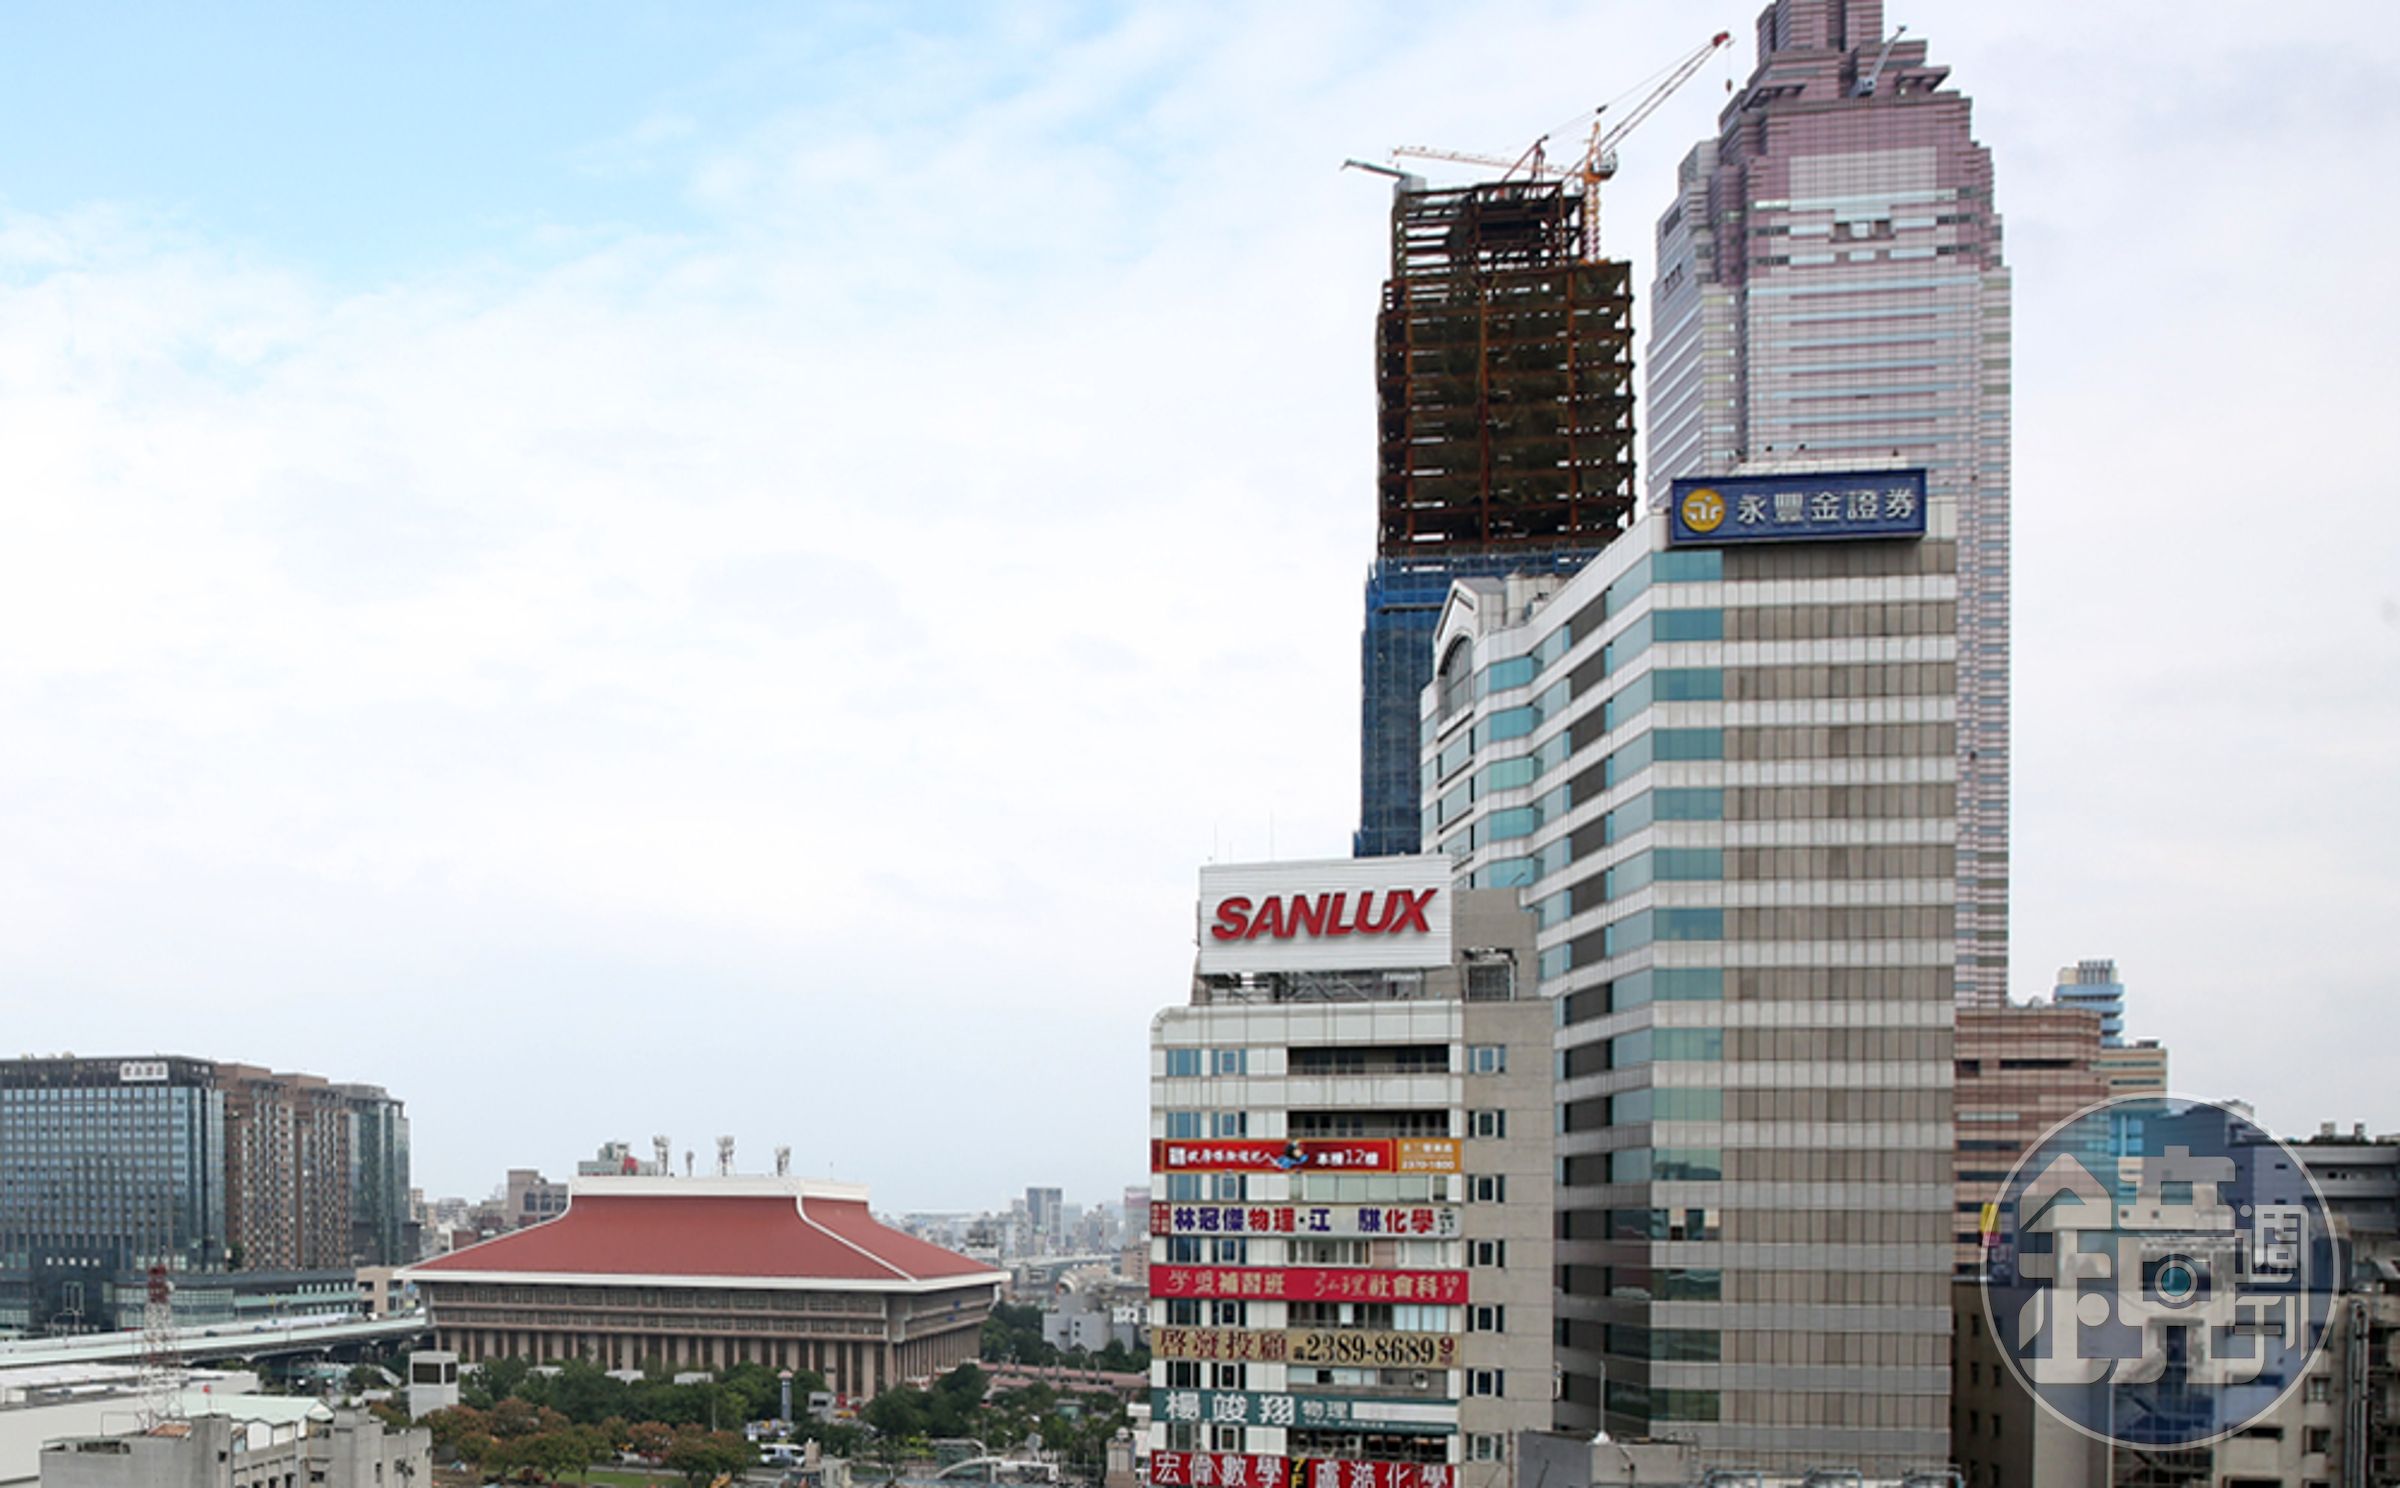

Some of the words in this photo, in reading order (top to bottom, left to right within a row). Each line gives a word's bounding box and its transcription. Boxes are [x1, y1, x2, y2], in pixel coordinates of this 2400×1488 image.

[1737, 489, 1917, 525] 永豐金證券
[1211, 887, 1439, 941] SANLUX
[1306, 1333, 1434, 1364] 2389-8689
